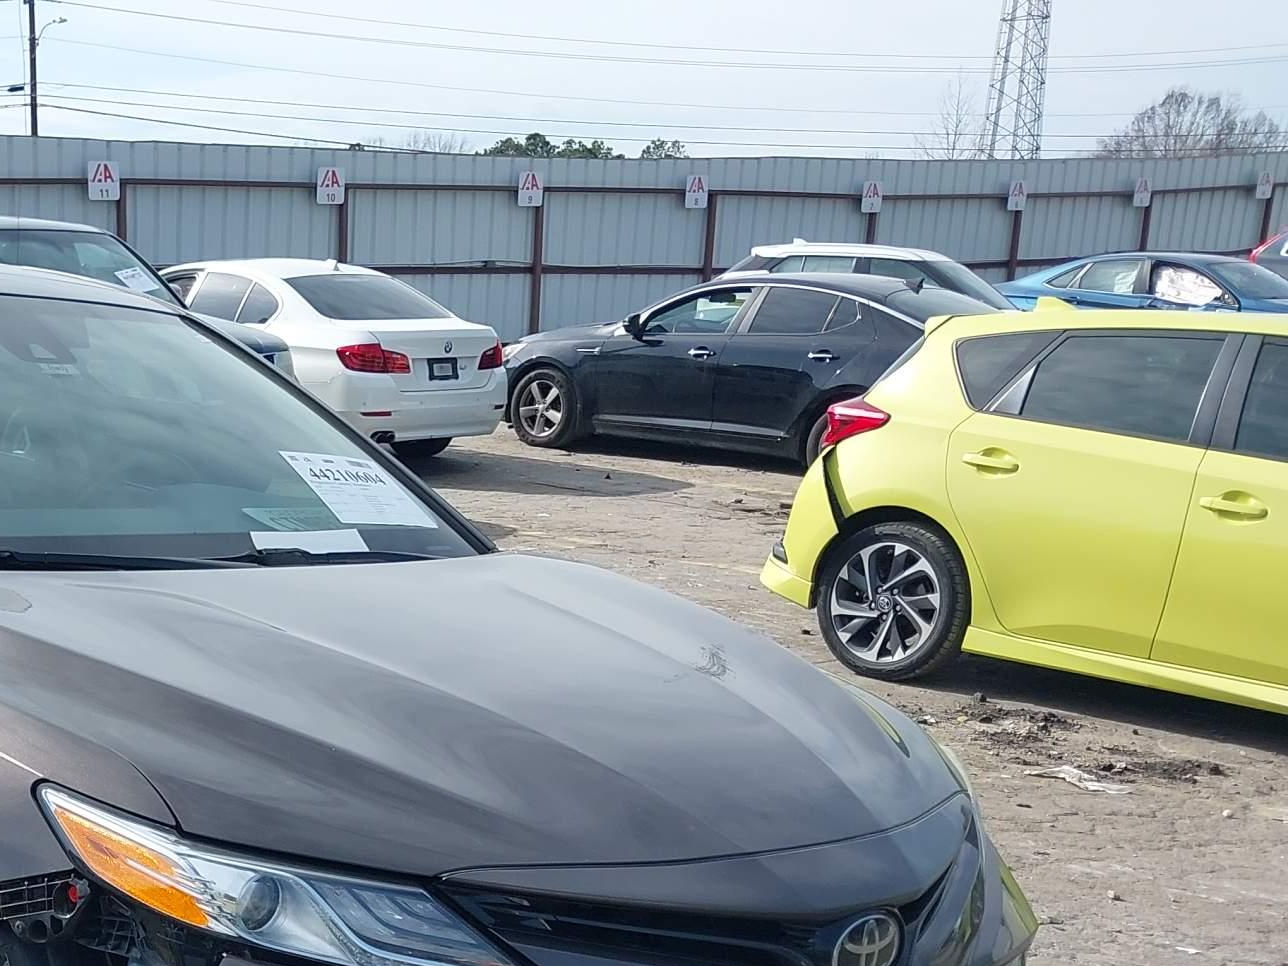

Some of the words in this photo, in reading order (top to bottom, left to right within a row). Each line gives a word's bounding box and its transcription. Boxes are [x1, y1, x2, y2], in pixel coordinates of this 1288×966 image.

[99, 189, 109, 198] 11
[326, 193, 336, 203] 10
[309, 467, 387, 486] 44210604
